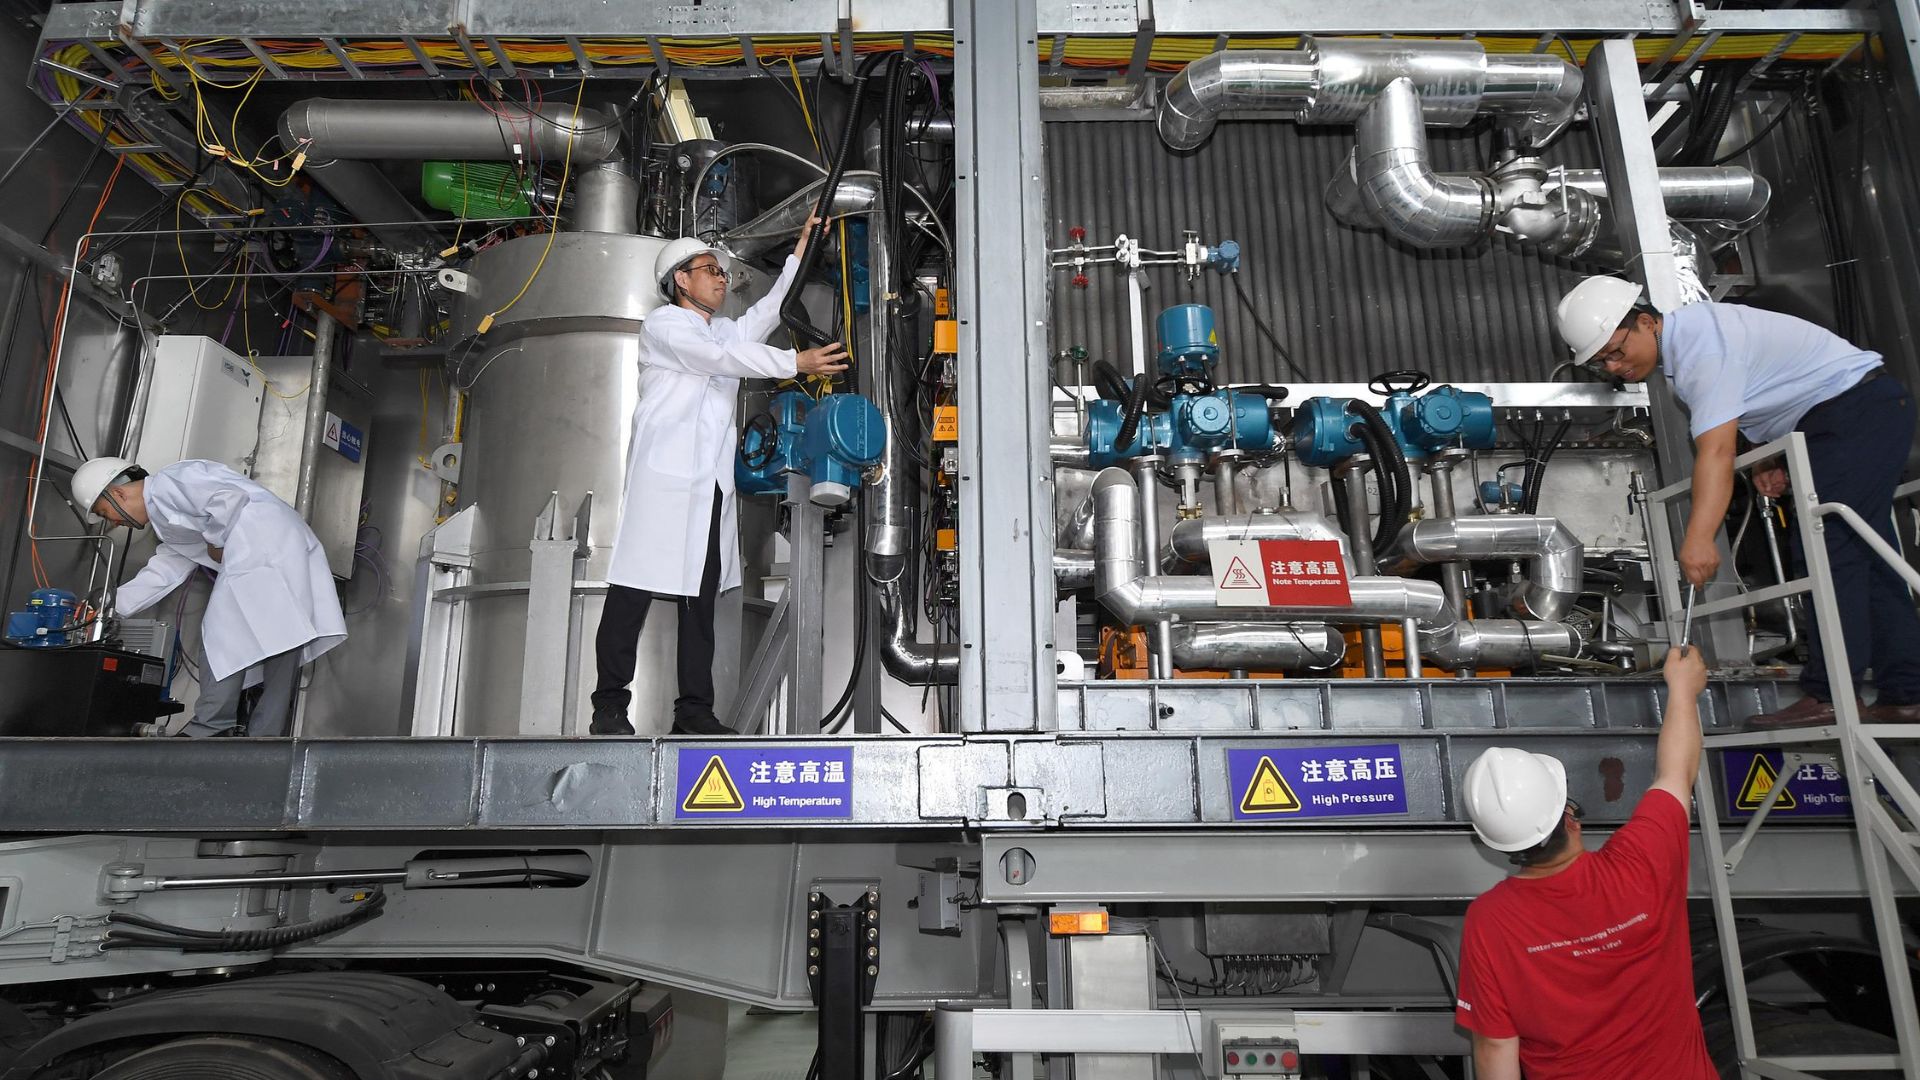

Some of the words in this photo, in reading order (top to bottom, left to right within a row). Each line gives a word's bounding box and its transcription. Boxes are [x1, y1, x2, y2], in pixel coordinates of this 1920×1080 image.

[1270, 561, 1340, 575] 注意高温
[1293, 578, 1341, 586] Temperature
[749, 760, 846, 784] 注意高温
[1300, 757, 1397, 783] 注意高压
[1797, 764, 1842, 781] 注意
[752, 796, 776, 808] High
[778, 796, 842, 808] Temperature
[1312, 794, 1340, 806] High
[1341, 792, 1395, 804] Pressure
[1803, 793, 1828, 806] High
